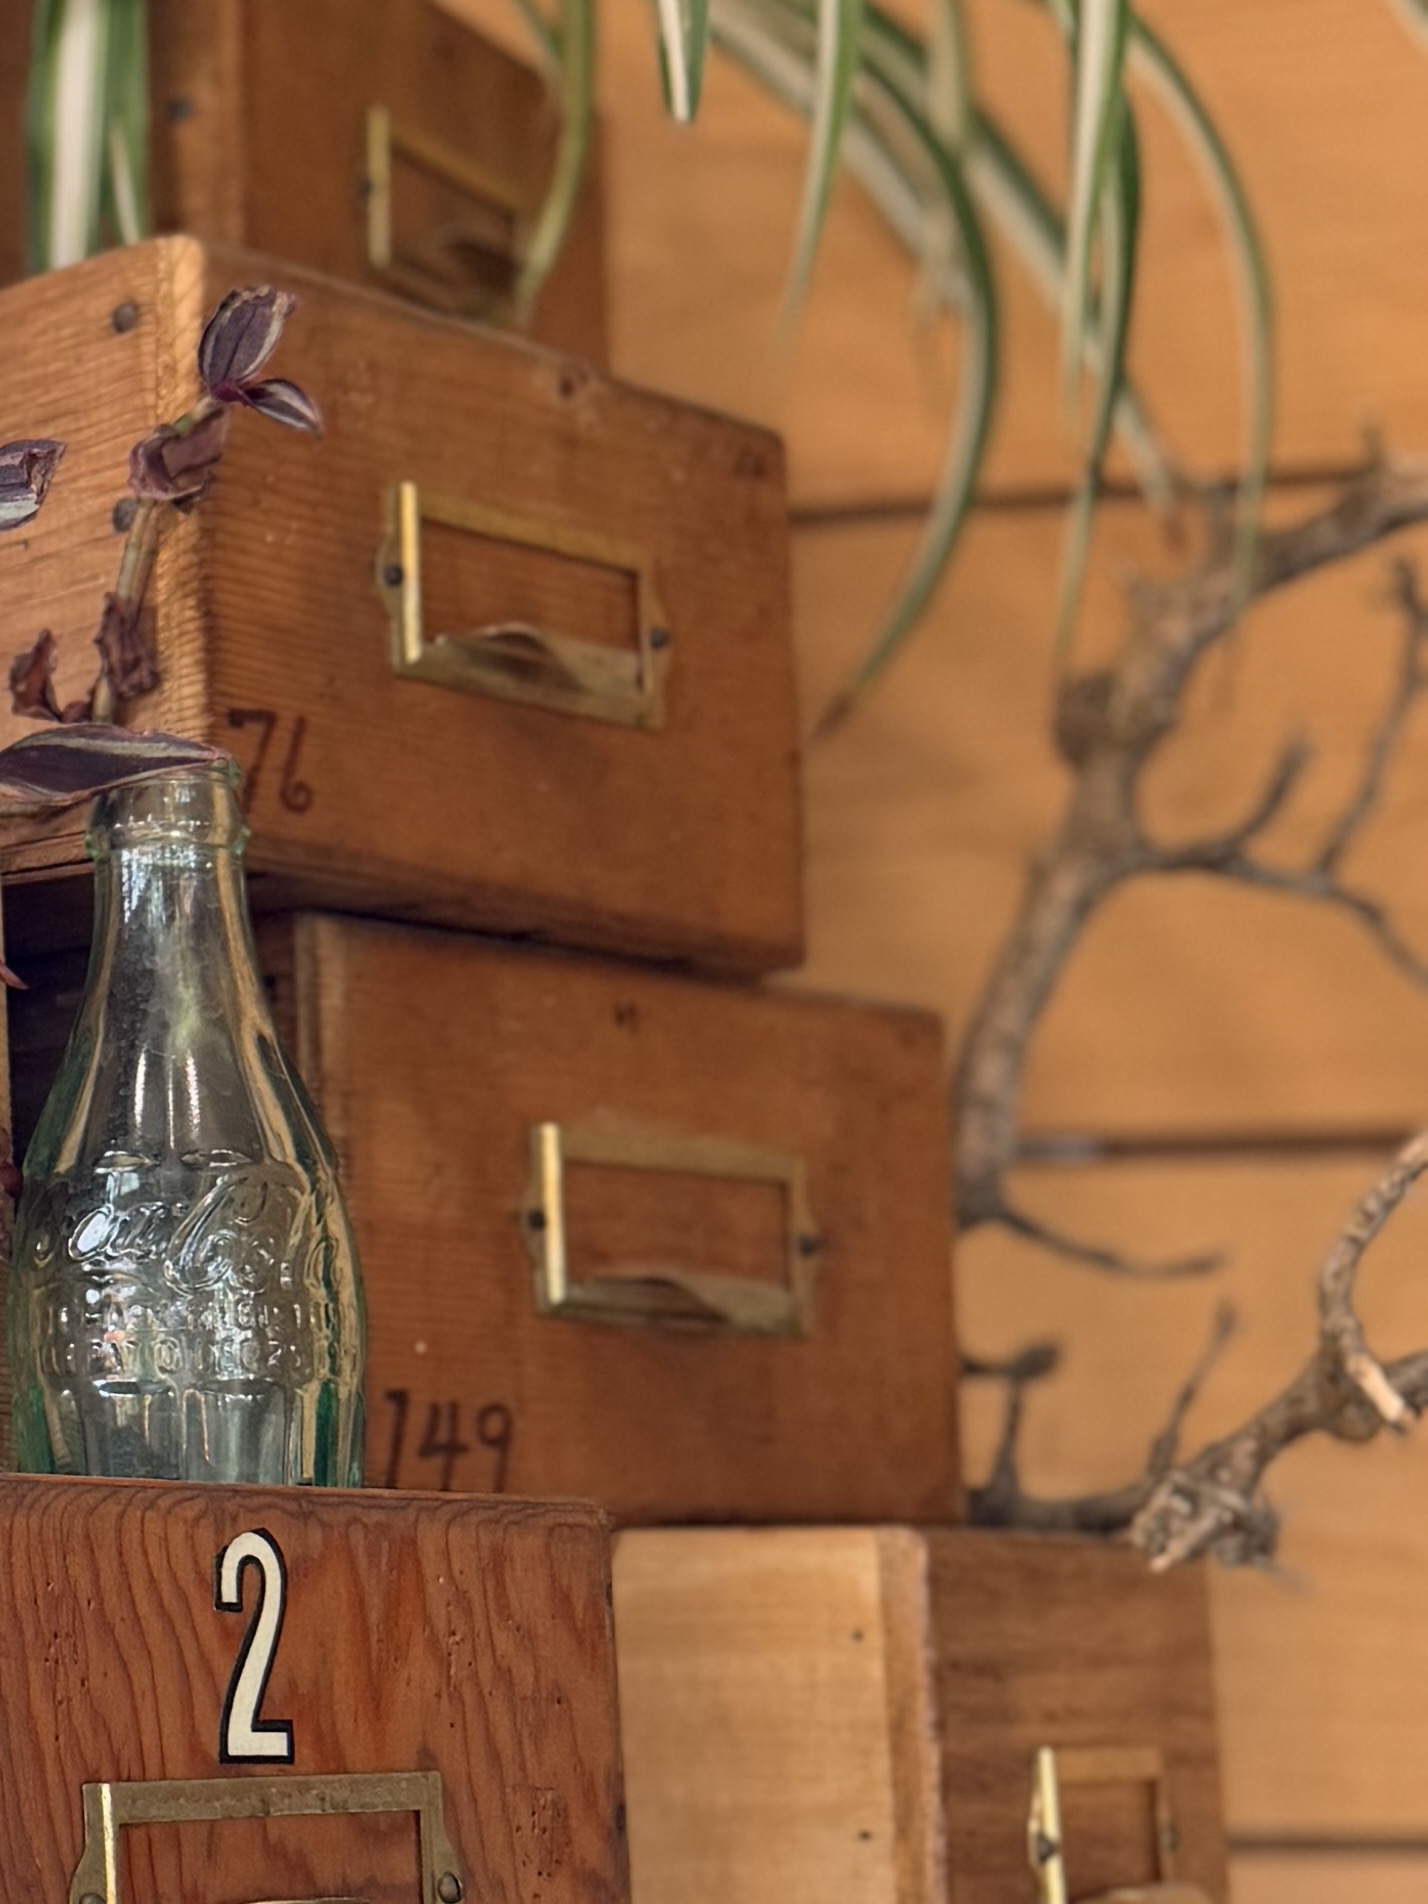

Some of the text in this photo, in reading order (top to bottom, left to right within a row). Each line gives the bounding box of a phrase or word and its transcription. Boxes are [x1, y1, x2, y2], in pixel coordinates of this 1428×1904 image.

[227, 708, 313, 815] 76
[384, 1389, 514, 1492] 149
[214, 1527, 295, 1764] 2
